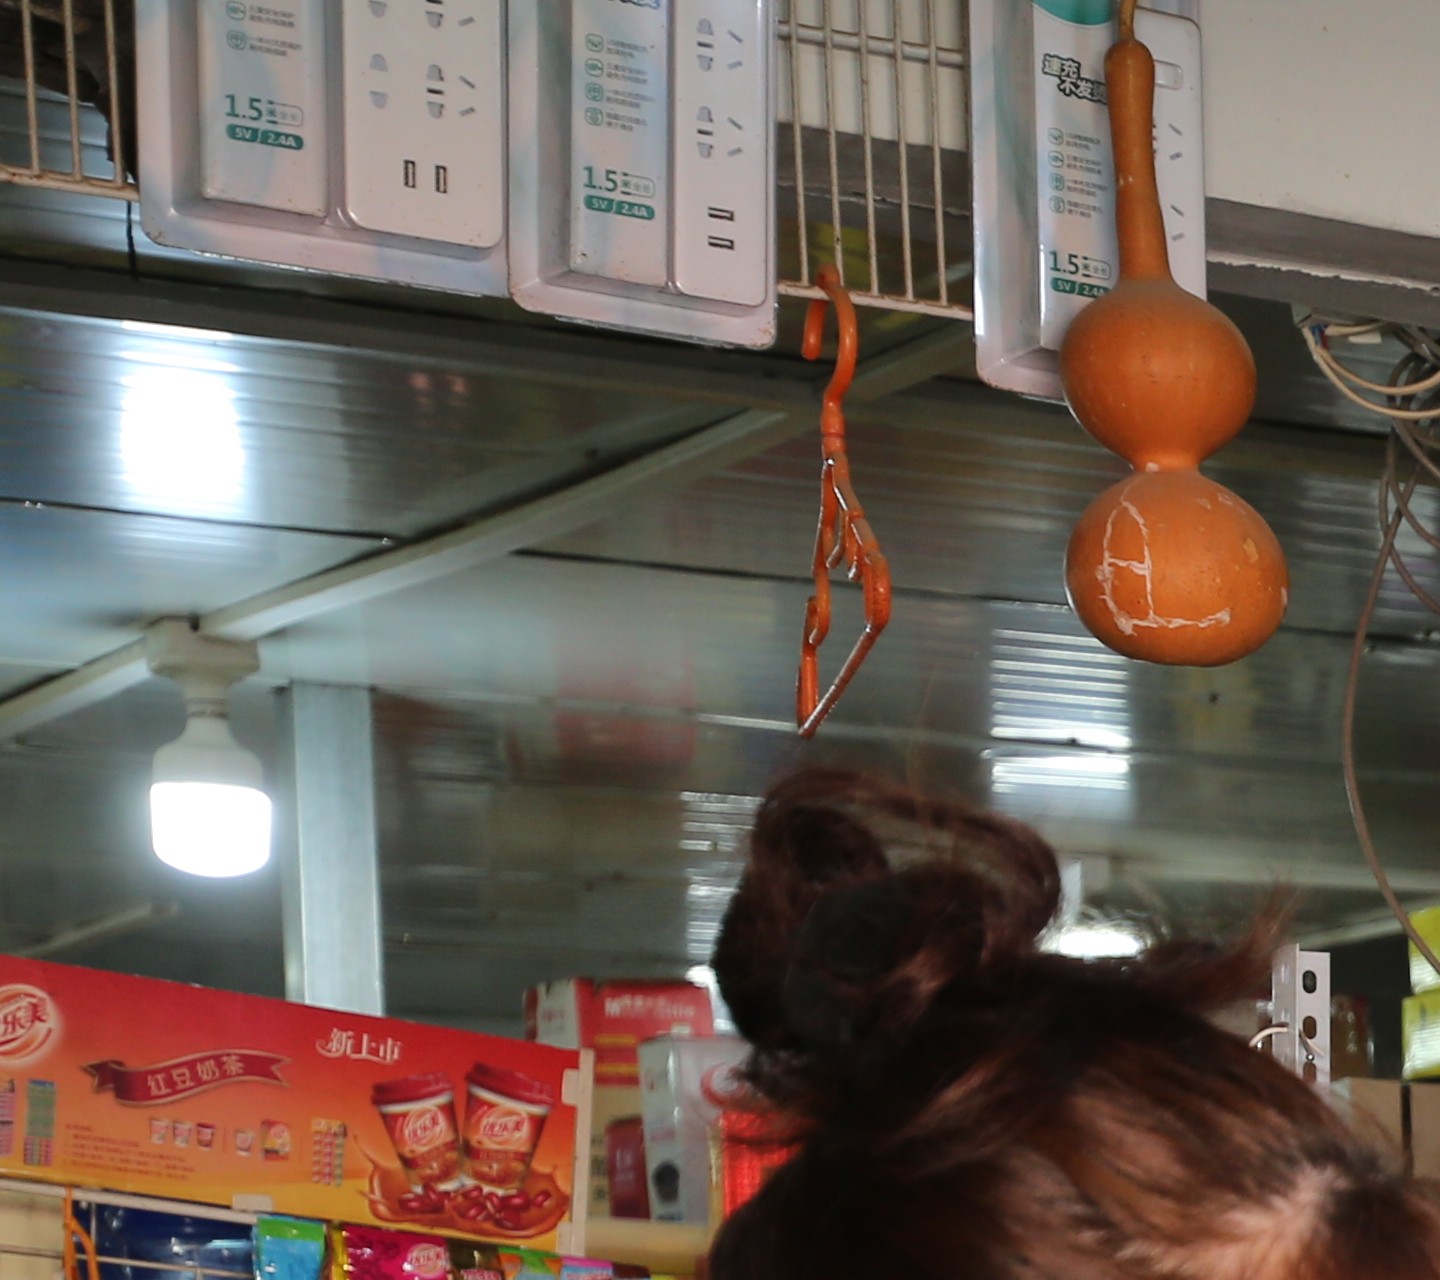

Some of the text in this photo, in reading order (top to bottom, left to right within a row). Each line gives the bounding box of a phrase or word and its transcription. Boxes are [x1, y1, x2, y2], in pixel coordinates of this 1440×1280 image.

[225, 94, 262, 121] 1.5
[267, 132, 297, 147] 2.4A
[583, 166, 618, 192] 1.5
[1050, 251, 1079, 275] 1.5
[316, 1028, 402, 1066] 新上市
[146, 1053, 247, 1097] 红豆奶茶
